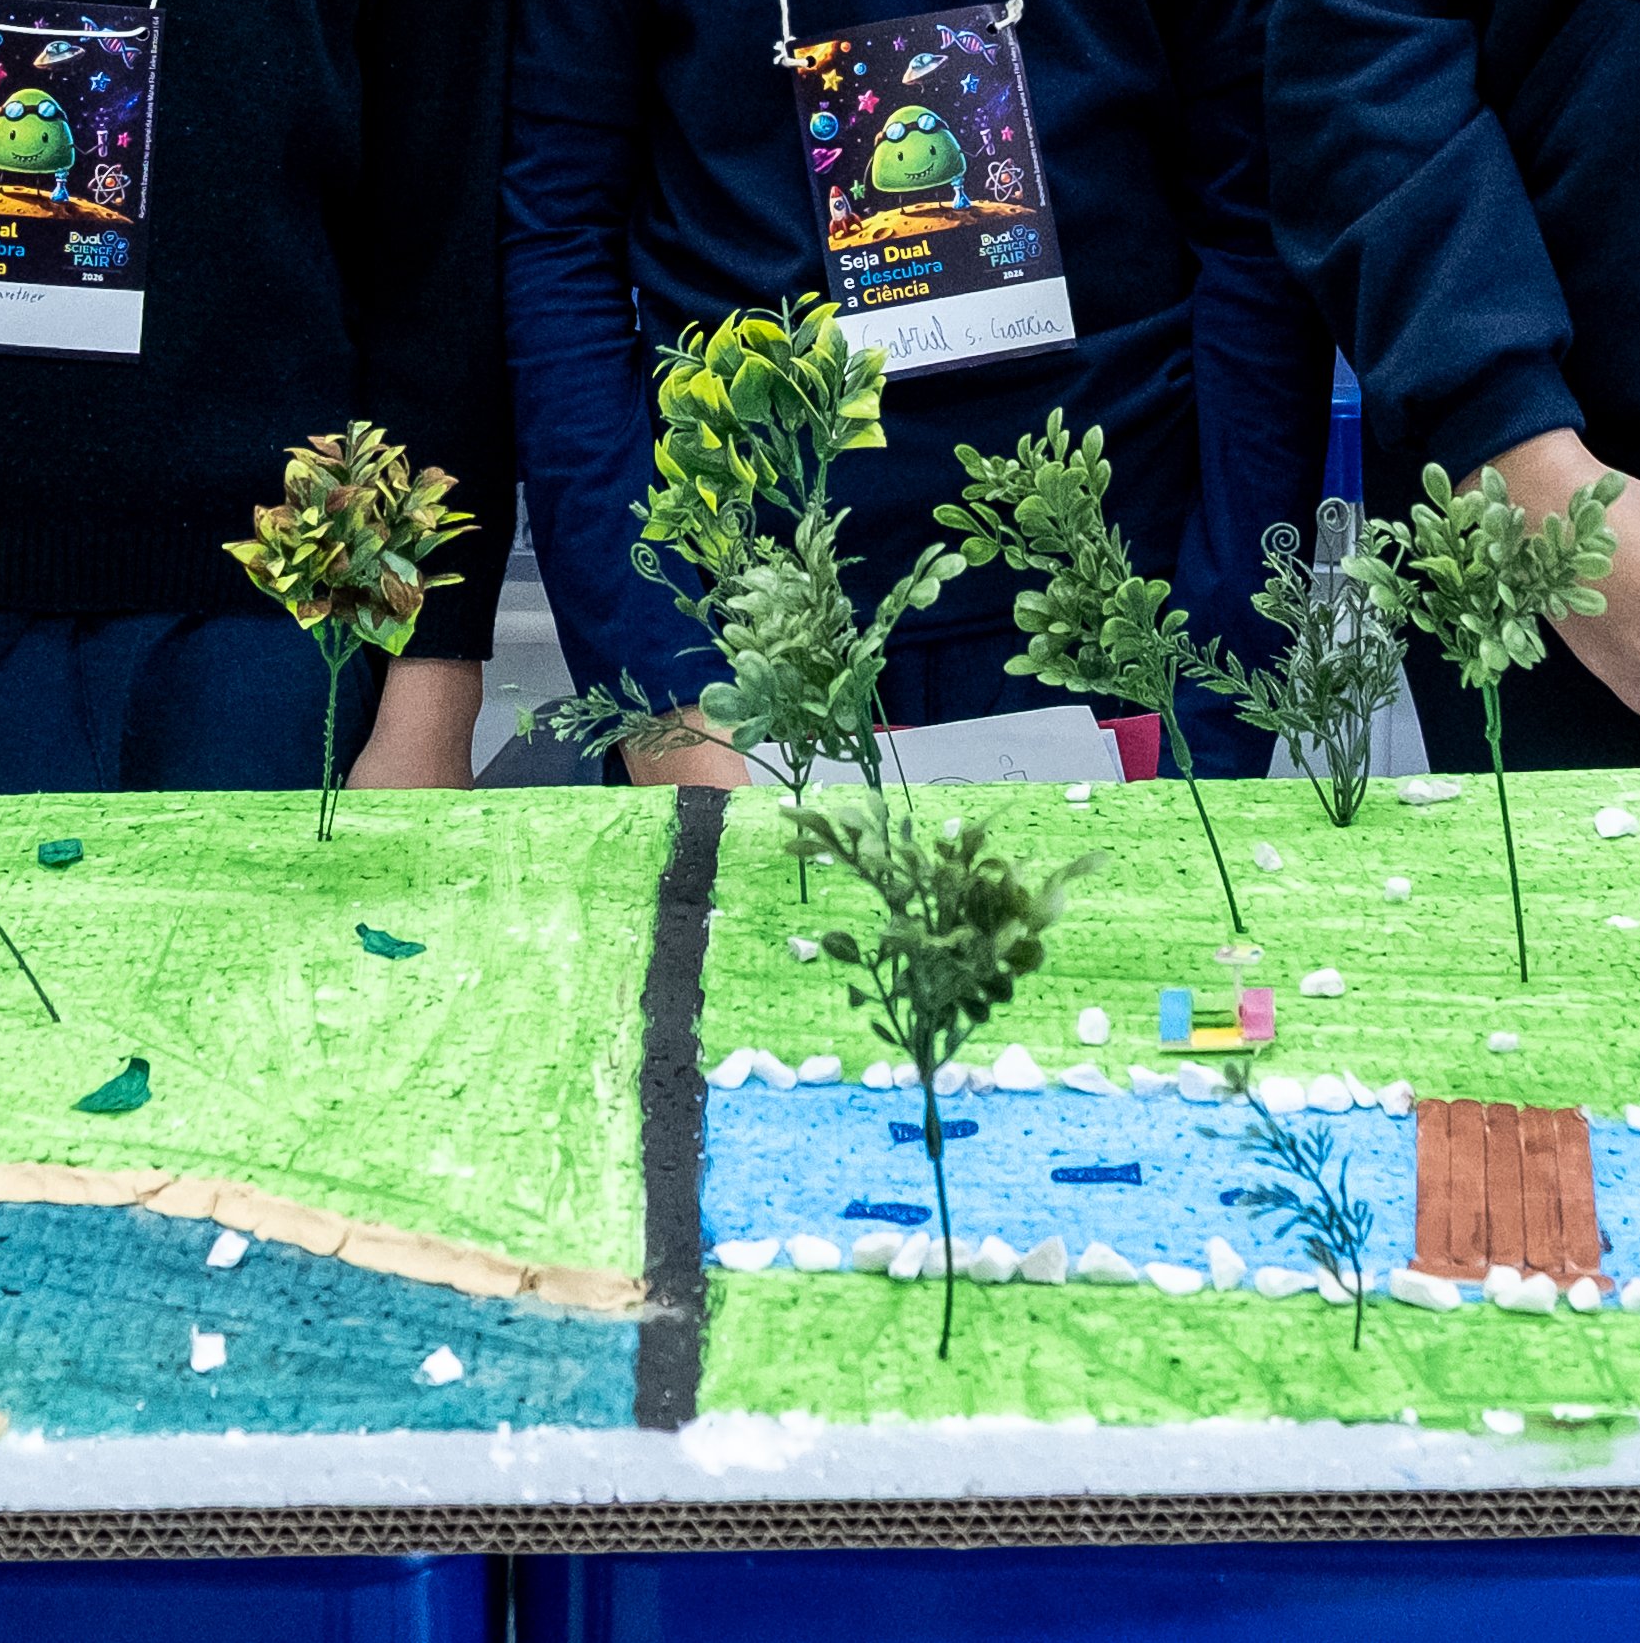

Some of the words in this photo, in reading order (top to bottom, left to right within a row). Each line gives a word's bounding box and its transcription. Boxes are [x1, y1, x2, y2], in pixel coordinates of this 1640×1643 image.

[69, 231, 102, 245] Dual
[981, 231, 1013, 246] Dual
[64, 244, 113, 256] SCIENCE
[840, 252, 880, 271] Seja
[884, 240, 931, 263] Dual
[979, 240, 1026, 256] SCIENCE
[74, 254, 110, 267] FAIR
[990, 250, 1025, 267] FAIR
[81, 272, 104, 282] 2026
[844, 277, 855, 289] e
[860, 260, 943, 287] descubra
[1003, 270, 1024, 280] 2026
[848, 295, 858, 308] a
[863, 281, 930, 306] Ciência
